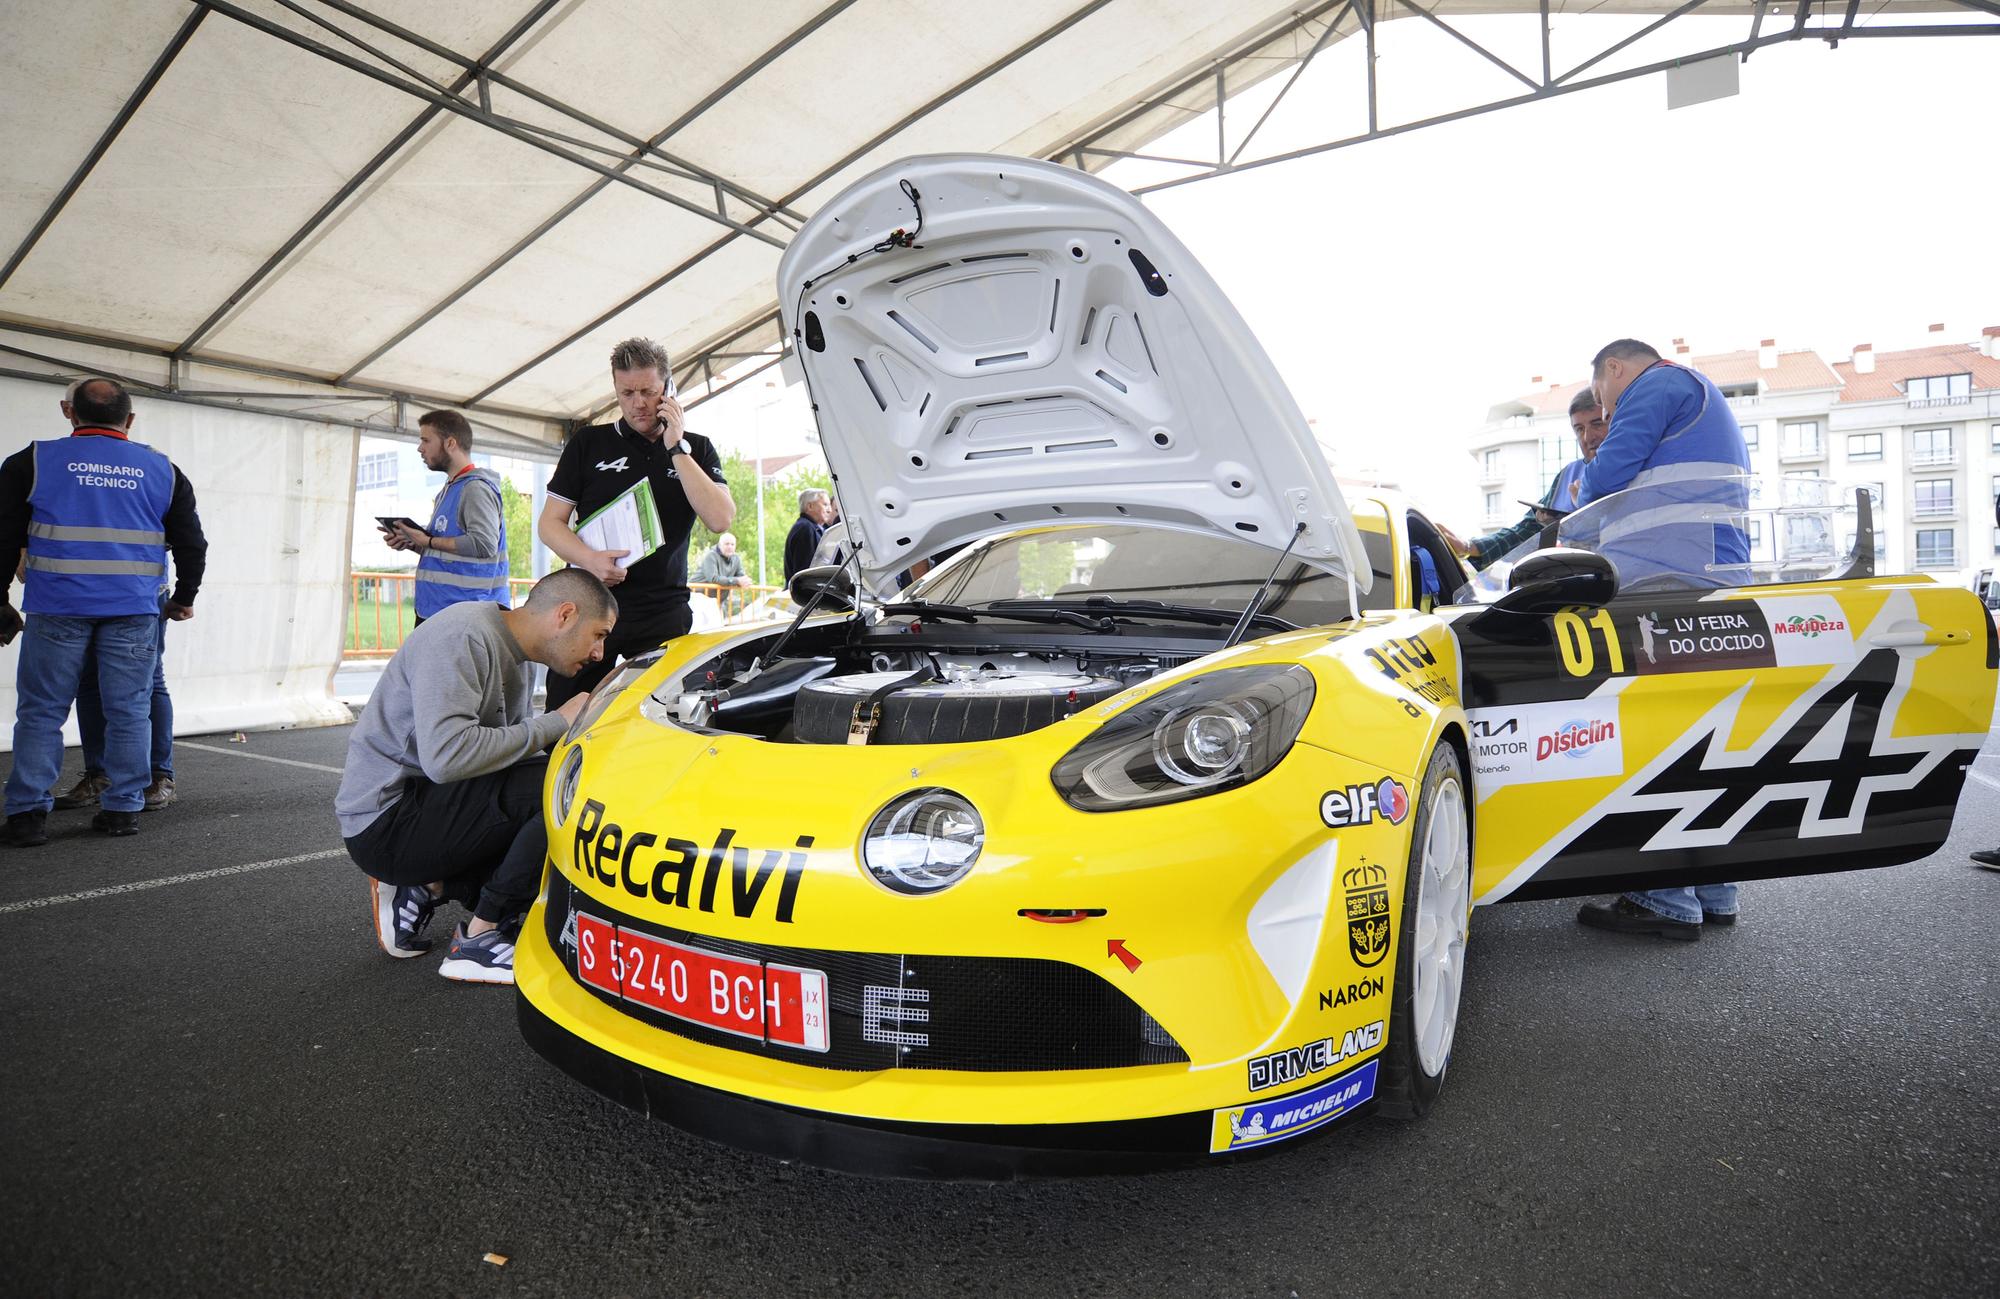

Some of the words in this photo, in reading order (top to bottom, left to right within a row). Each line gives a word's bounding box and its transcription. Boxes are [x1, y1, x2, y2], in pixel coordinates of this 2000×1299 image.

[67, 462, 145, 478] COMISARIO
[76, 474, 138, 490] TÉCNICO
[1674, 617, 1693, 632] LV
[1697, 614, 1749, 631] FEIRA
[1774, 620, 1845, 635] MaxiDeza
[1553, 606, 1625, 678] 01
[1668, 638, 1695, 654] DO
[1699, 634, 1766, 652] COCIDO
[1479, 741, 1528, 757] MOTOR
[1536, 719, 1616, 761] Disiclin
[1320, 784, 1377, 827] elf
[573, 797, 816, 924] Recalvi
[582, 929, 596, 971] S
[610, 938, 689, 1003] 5240
[708, 967, 781, 1028] BCH
[1319, 976, 1385, 1011] NARÓN
[805, 1012, 819, 1028] 23
[1249, 1020, 1385, 1092] DRIVELAND
[1269, 1080, 1363, 1130] MICHELIN
